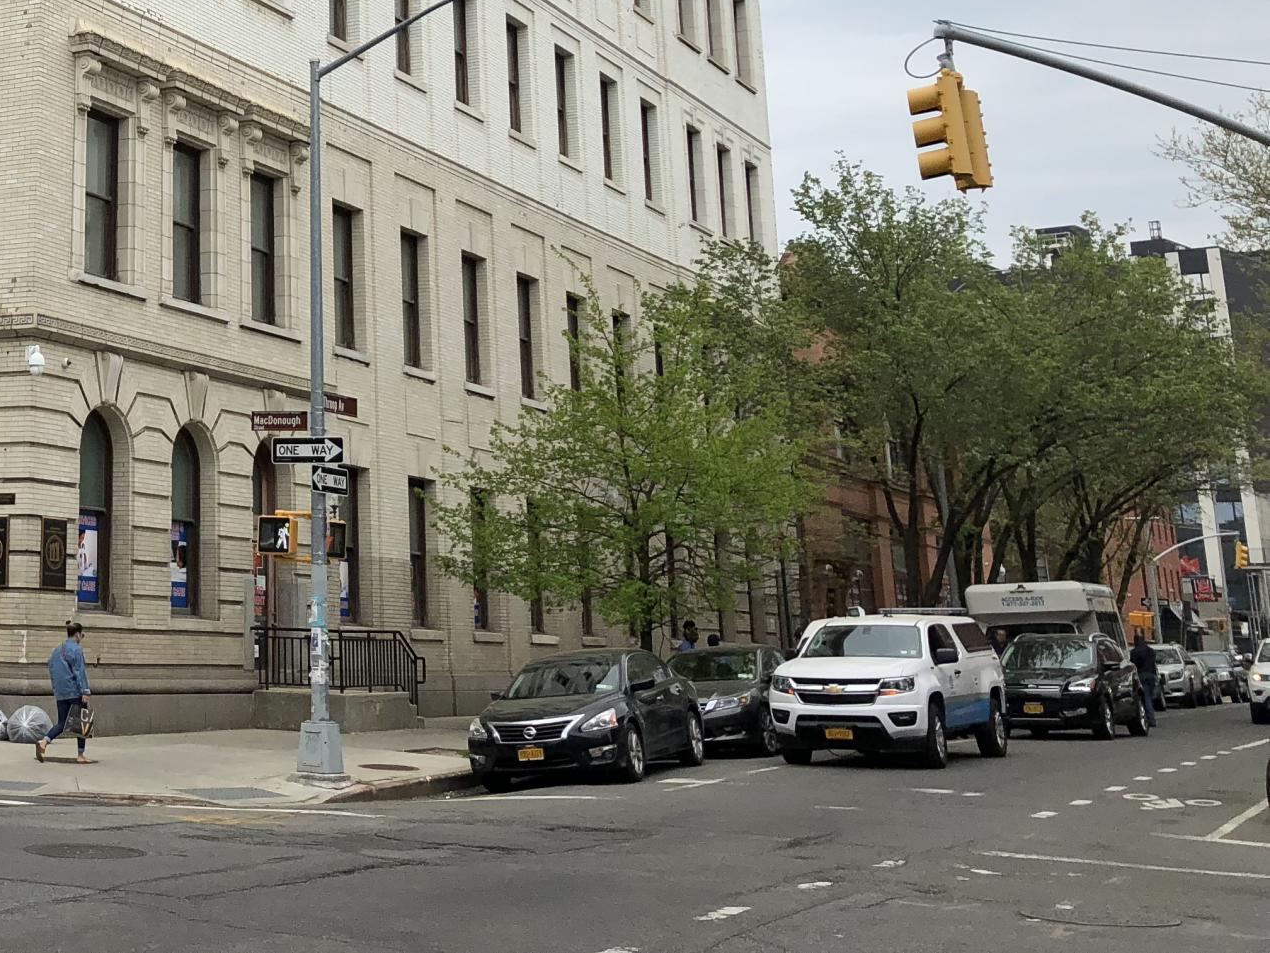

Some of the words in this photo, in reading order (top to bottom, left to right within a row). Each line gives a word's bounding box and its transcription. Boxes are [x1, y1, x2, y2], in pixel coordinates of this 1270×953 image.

[254, 415, 301, 427] MacDonough
[278, 445, 300, 456] ONE
[311, 445, 334, 456] WAY
[316, 473, 328, 485] ONE
[333, 476, 345, 487] WAY
